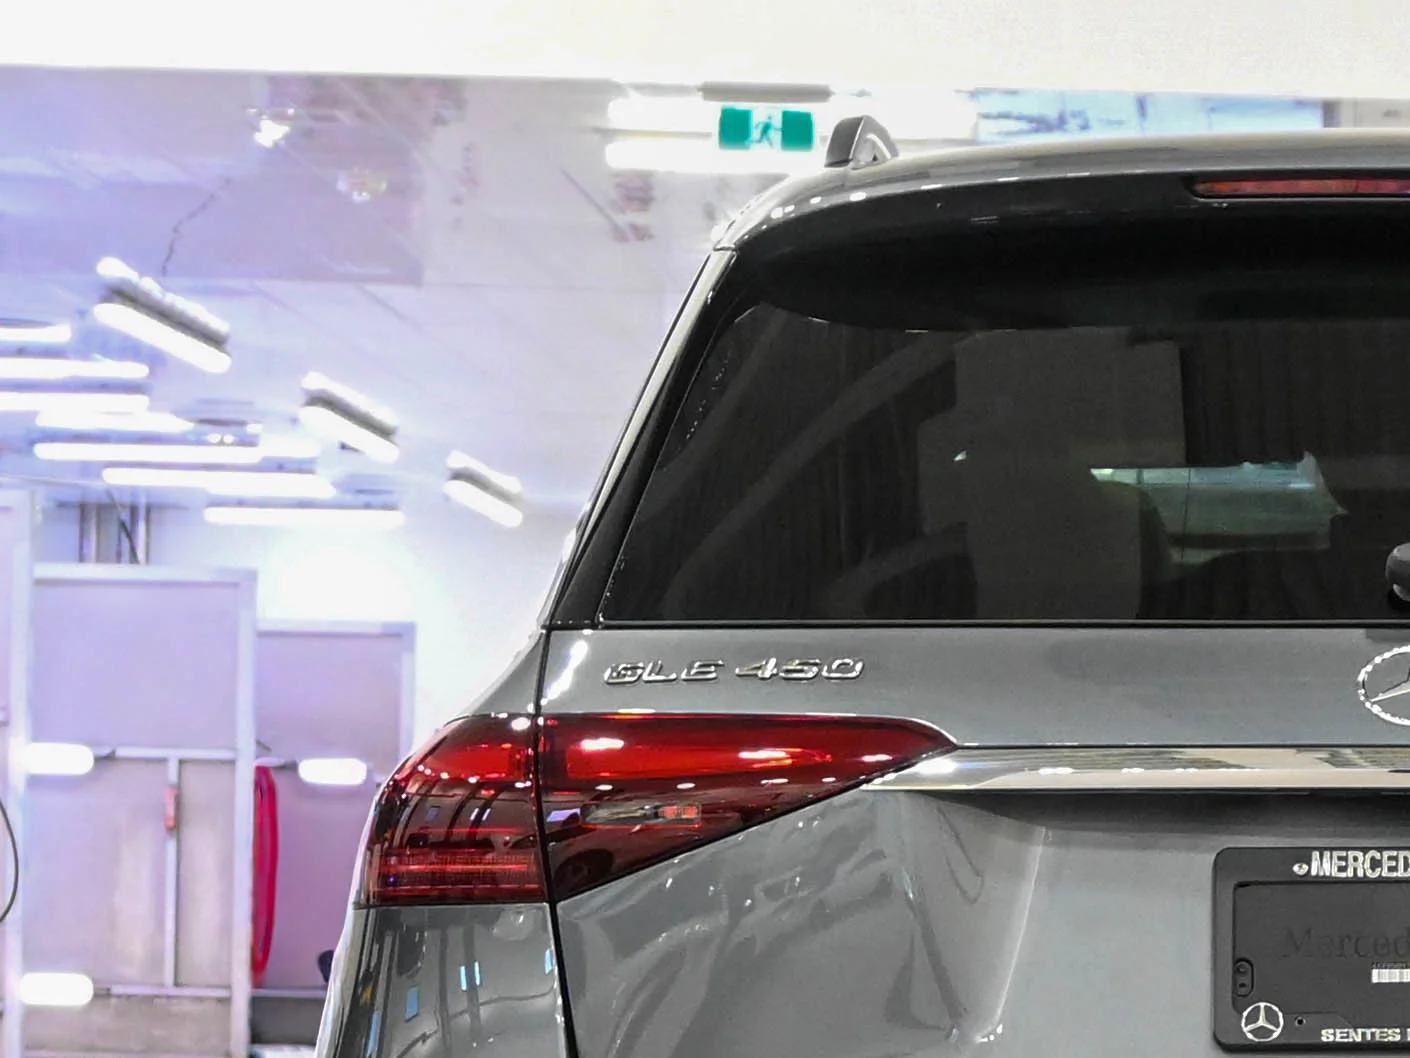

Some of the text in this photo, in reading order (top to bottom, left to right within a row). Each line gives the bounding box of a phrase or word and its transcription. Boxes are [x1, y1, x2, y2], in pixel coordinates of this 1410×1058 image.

[603, 656, 864, 684] GLE 450
[1320, 1027, 1402, 1043] SENTES
